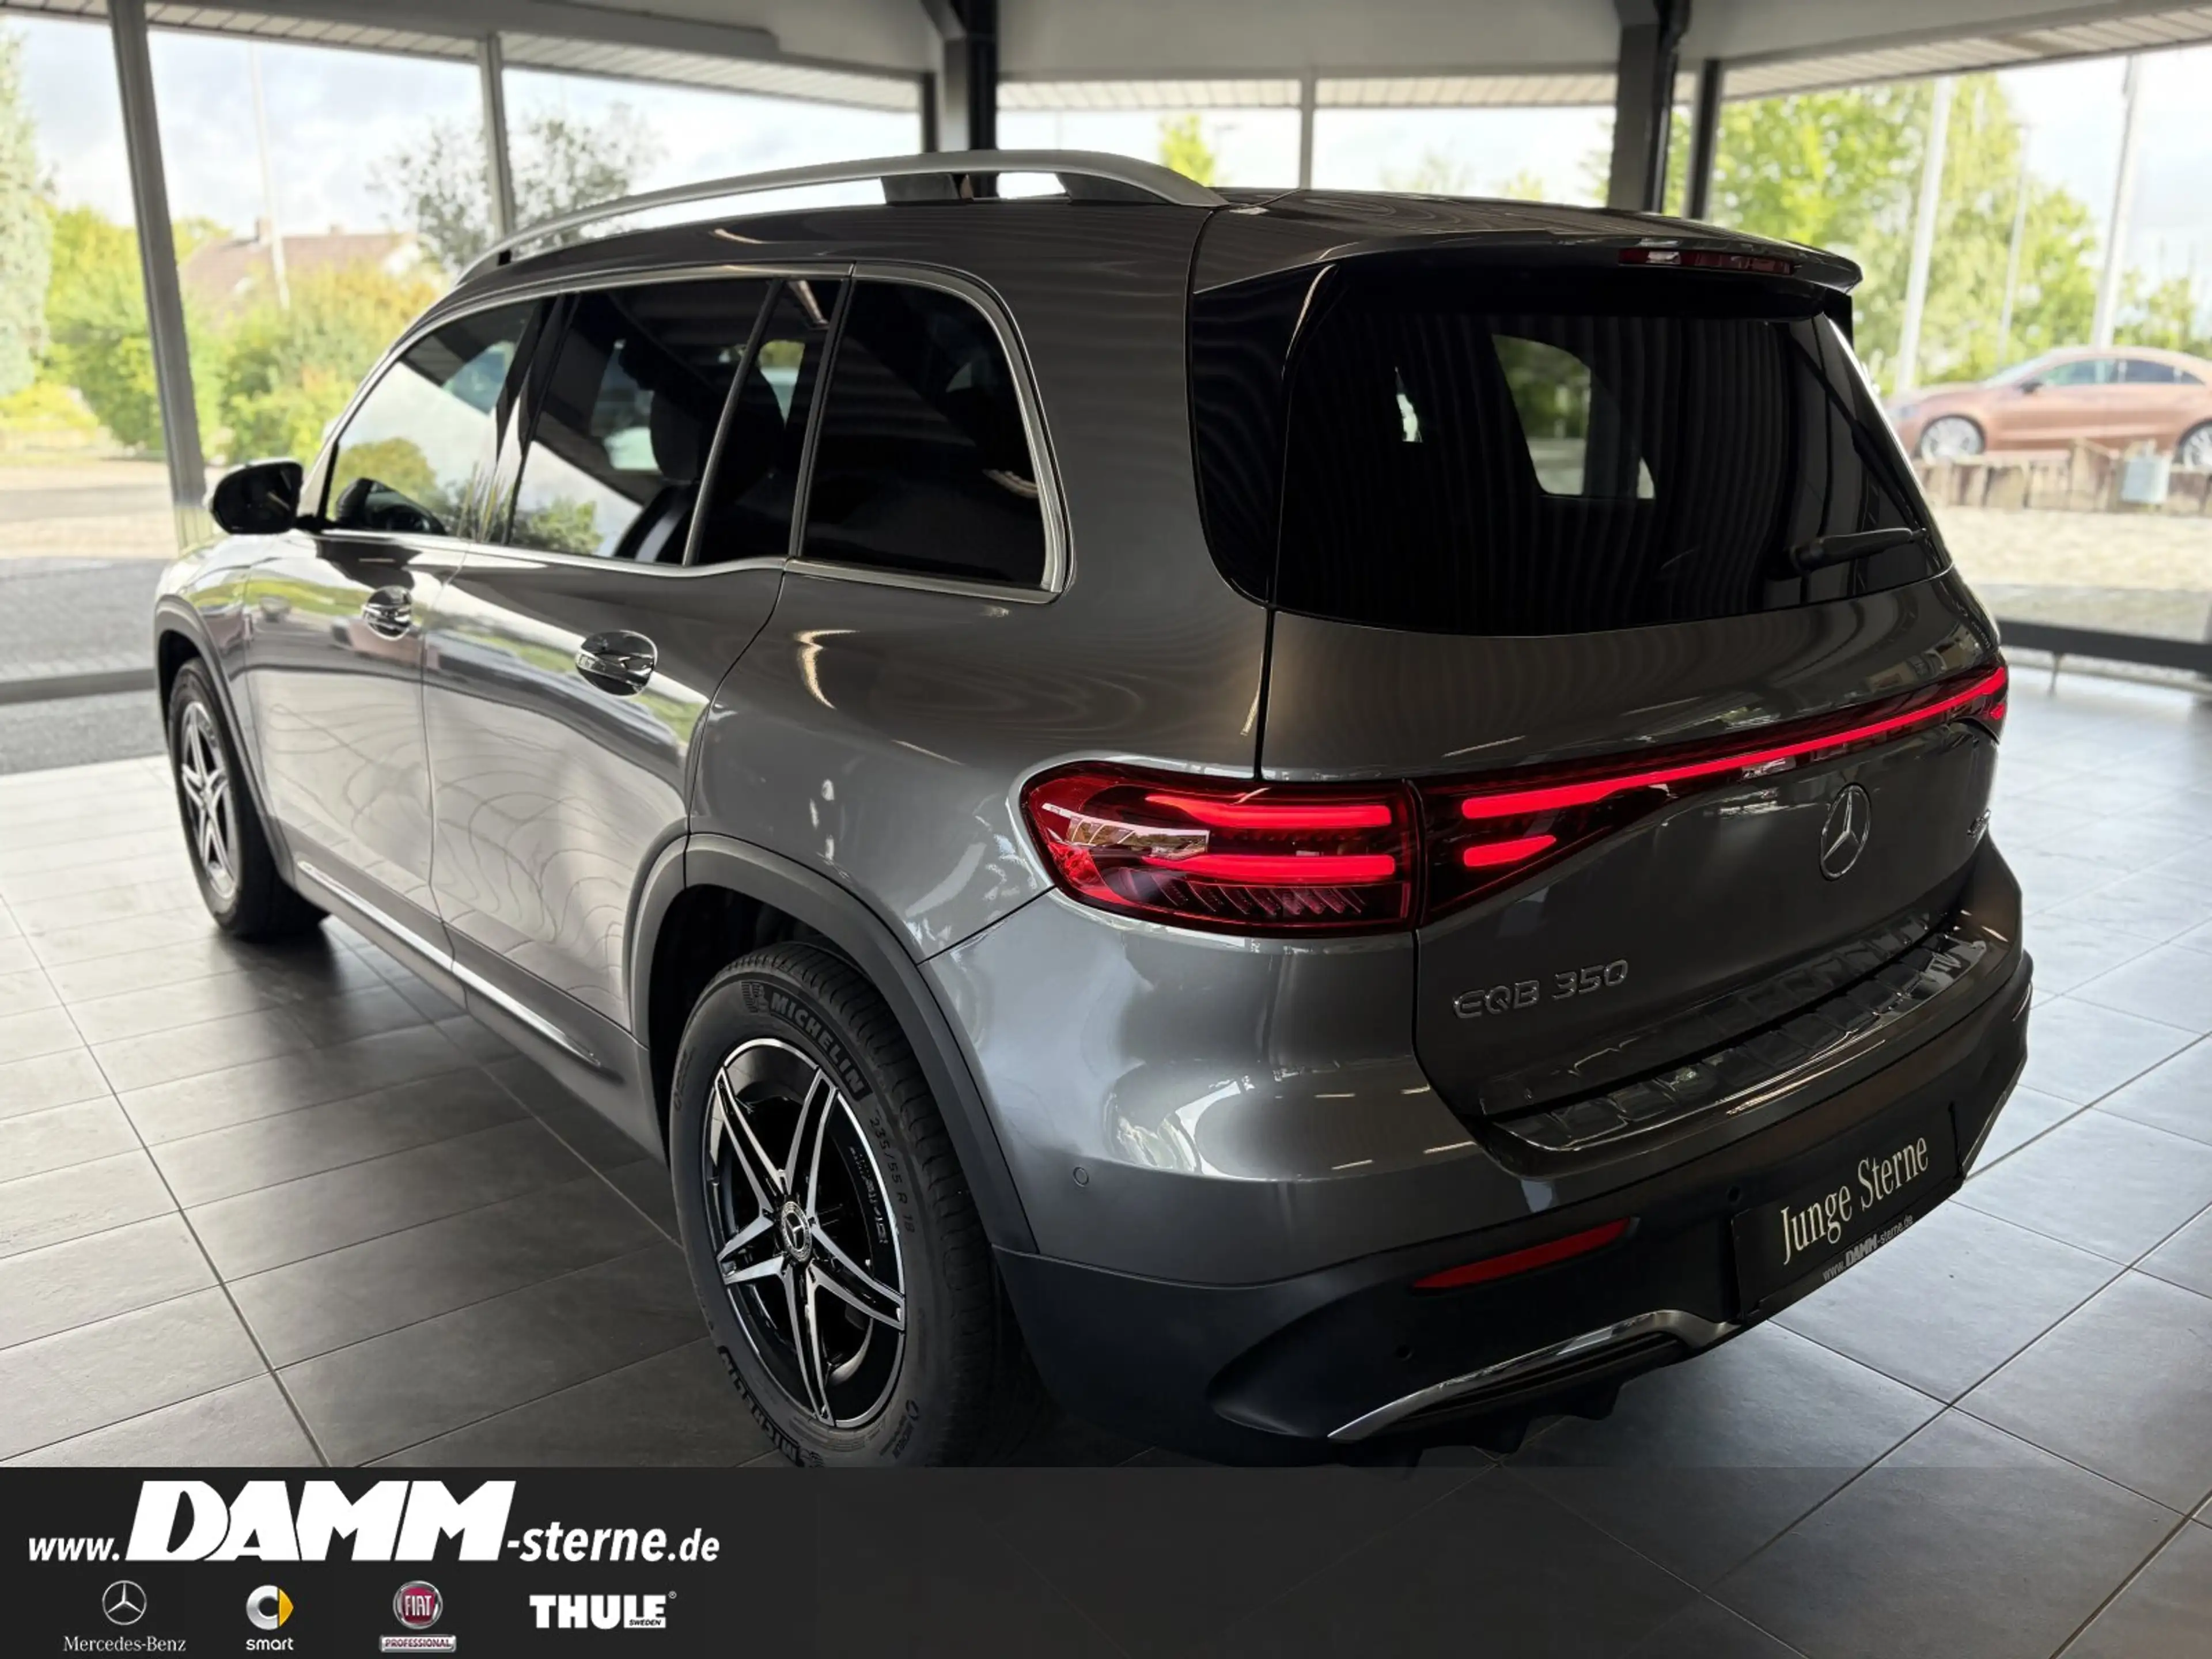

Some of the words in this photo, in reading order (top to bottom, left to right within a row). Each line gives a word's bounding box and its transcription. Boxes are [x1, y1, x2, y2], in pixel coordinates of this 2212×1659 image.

[1452, 980, 1540, 1018] EQB
[1551, 959, 1628, 1001] 350
[771, 991, 865, 1094] MICHELIN
[1781, 1185, 1851, 1264] Junge
[1858, 1137, 1929, 1211] Sterne
